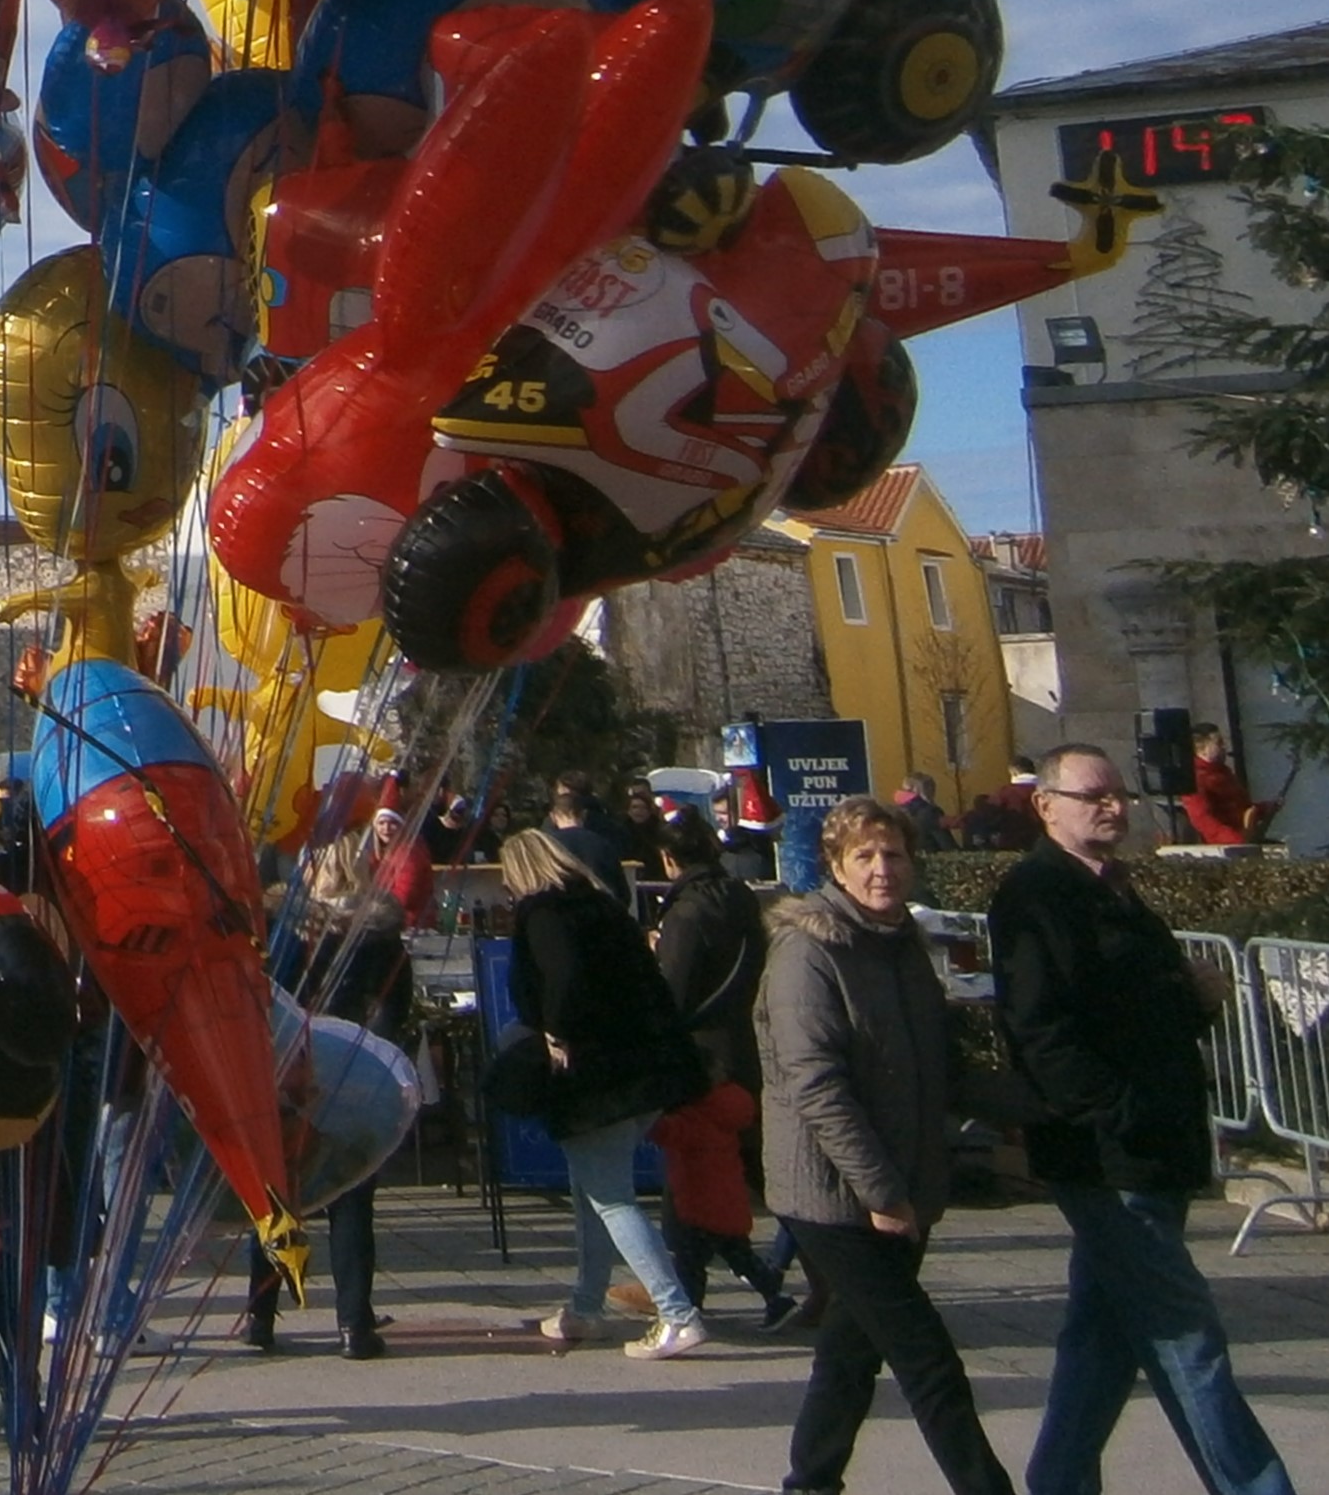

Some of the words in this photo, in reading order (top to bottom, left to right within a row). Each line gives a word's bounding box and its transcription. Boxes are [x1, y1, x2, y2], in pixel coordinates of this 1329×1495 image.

[879, 266, 966, 310] 81-8
[533, 302, 594, 349] GRABO
[483, 380, 547, 414] 45
[788, 758, 849, 771] UVIJEK
[804, 776, 837, 789] PUN
